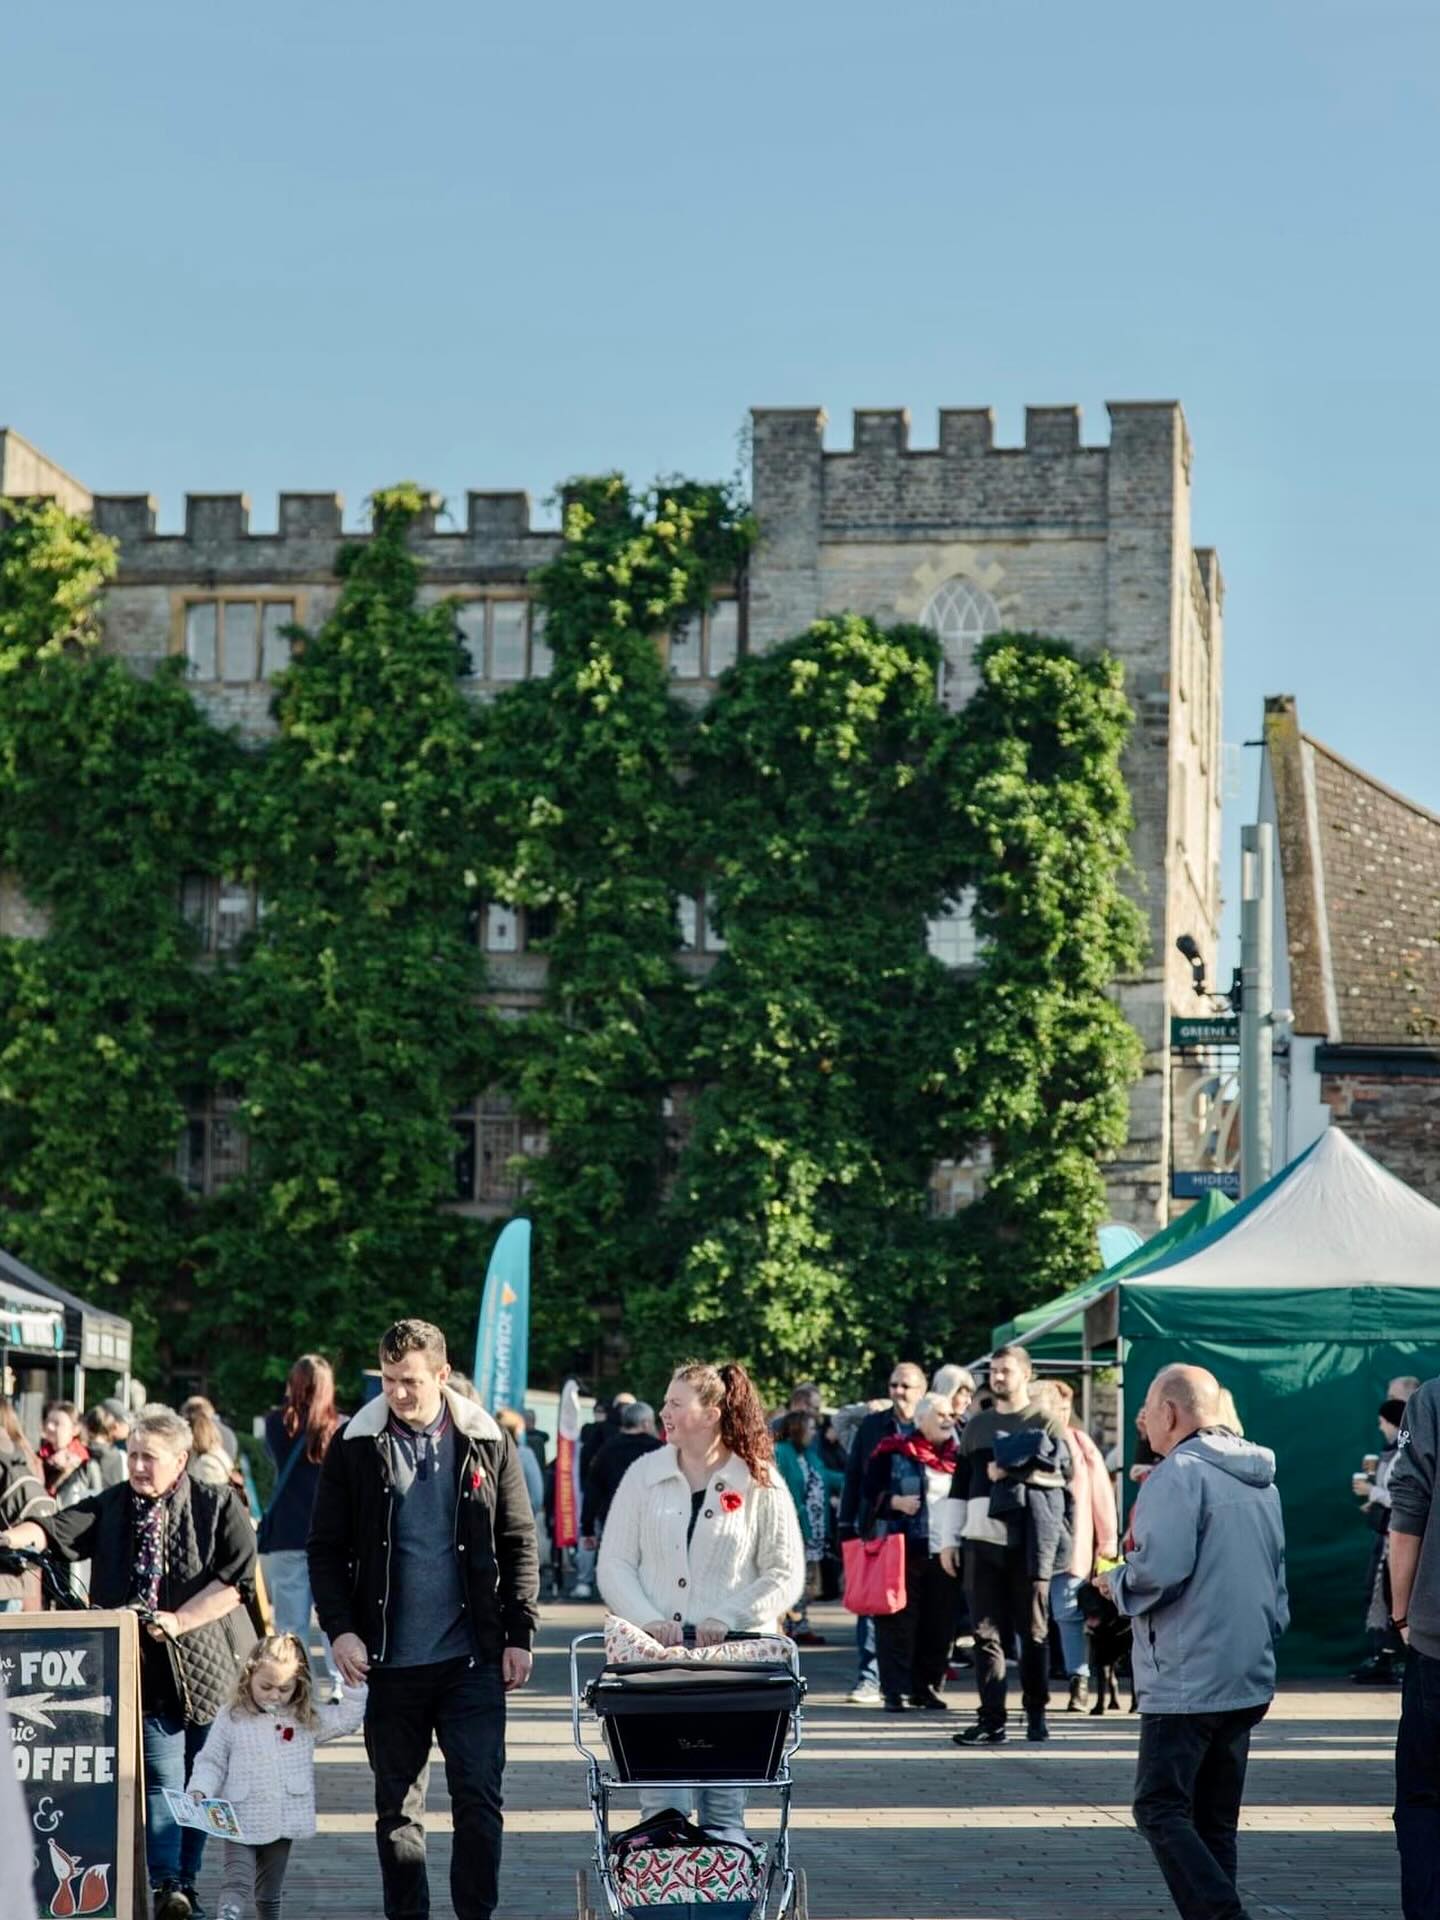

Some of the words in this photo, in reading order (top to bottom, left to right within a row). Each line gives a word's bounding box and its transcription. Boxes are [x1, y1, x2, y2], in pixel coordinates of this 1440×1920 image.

[1180, 1026, 1226, 1037] GREENE
[20, 1650, 87, 1686] FOX
[12, 1745, 116, 1784] OFFEE
[33, 1796, 64, 1832] &
